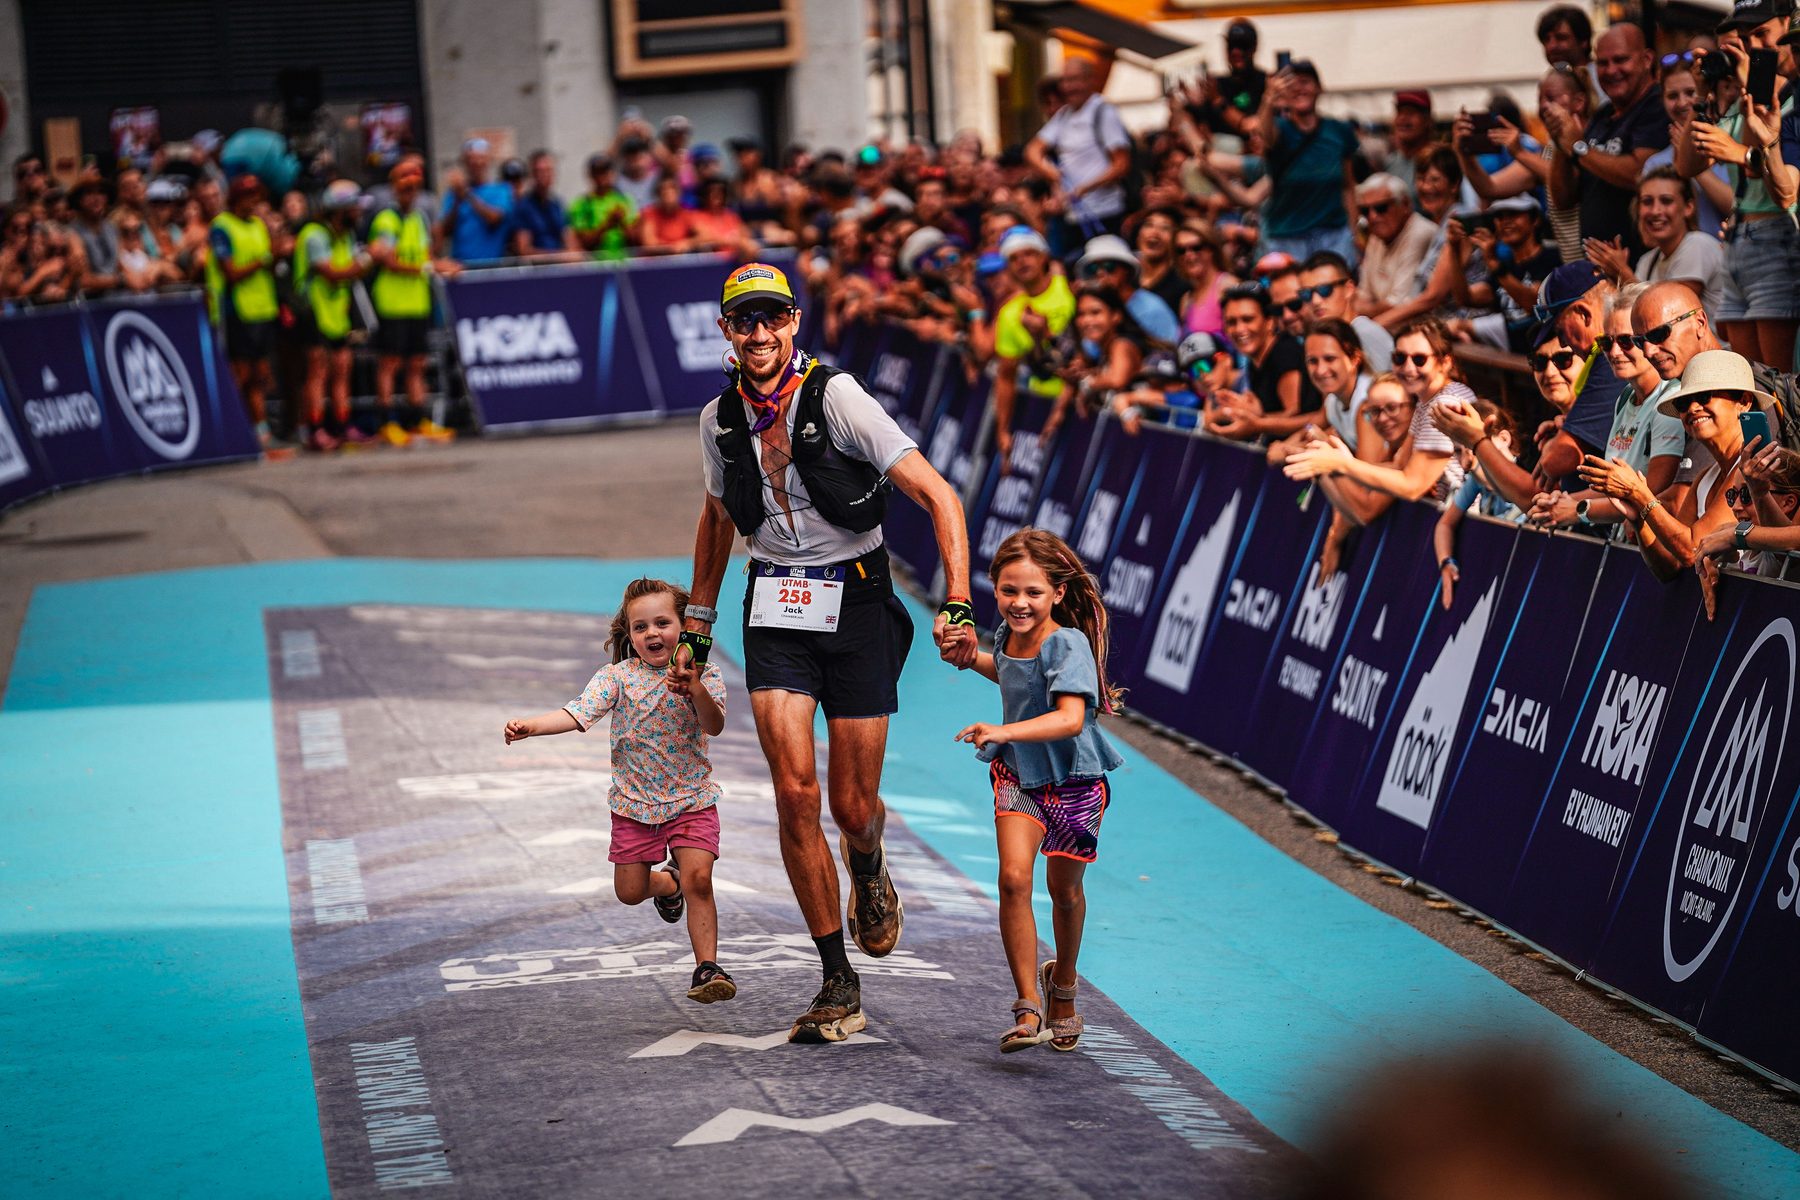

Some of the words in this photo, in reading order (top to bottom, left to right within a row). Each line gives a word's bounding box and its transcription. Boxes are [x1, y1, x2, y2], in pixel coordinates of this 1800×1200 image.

[456, 311, 578, 366] HOKA
[24, 391, 101, 438] SUUNTO
[778, 588, 812, 605] 258
[783, 605, 804, 615] Jack
[1483, 686, 1551, 754] DACIA
[1580, 669, 1667, 787] HOKA
[1562, 788, 1588, 827] FLY
[1575, 793, 1617, 844] HUMAN
[1610, 806, 1631, 848] FLY
[1684, 843, 1736, 893] CHAMONIX
[1679, 890, 1716, 923] MONT-BLANC
[348, 1036, 432, 1111] MONT-BLANC
